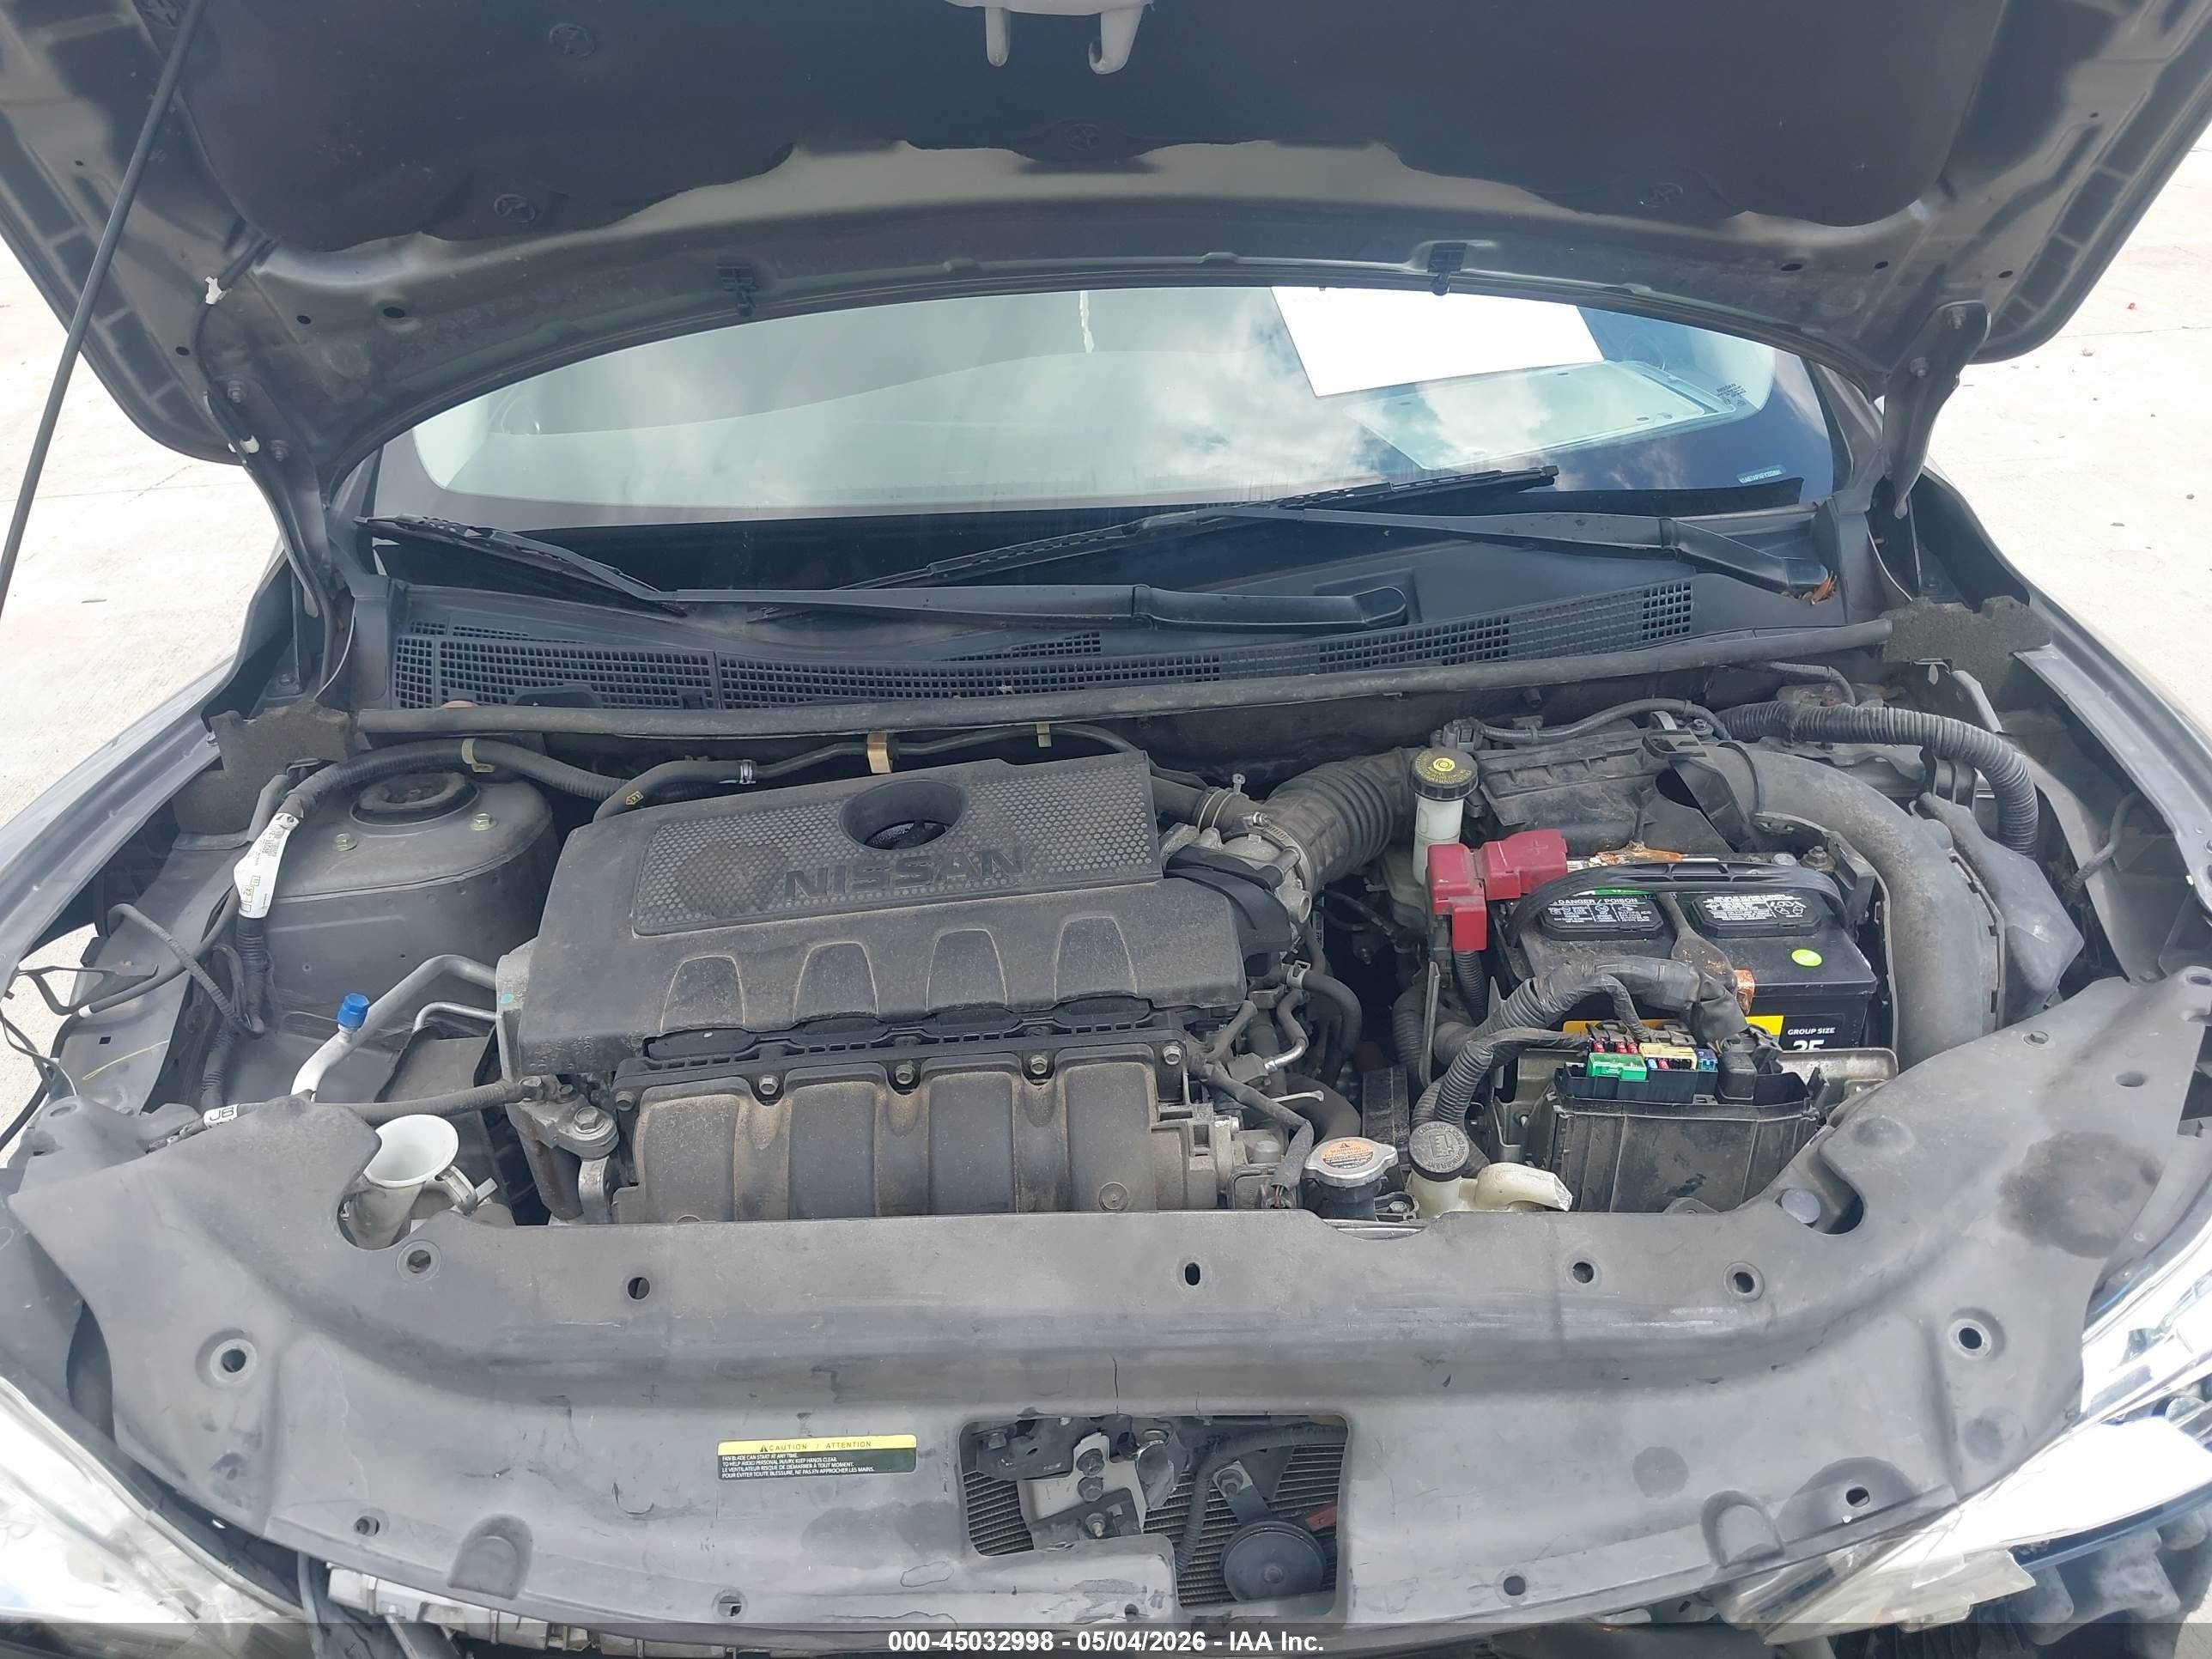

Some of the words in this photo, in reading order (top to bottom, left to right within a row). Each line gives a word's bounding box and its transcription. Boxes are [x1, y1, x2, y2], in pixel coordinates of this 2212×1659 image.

[785, 849, 1025, 902] NISSAN
[210, 1106, 234, 1121] JB
[826, 1441, 872, 1449] ATTENTION
